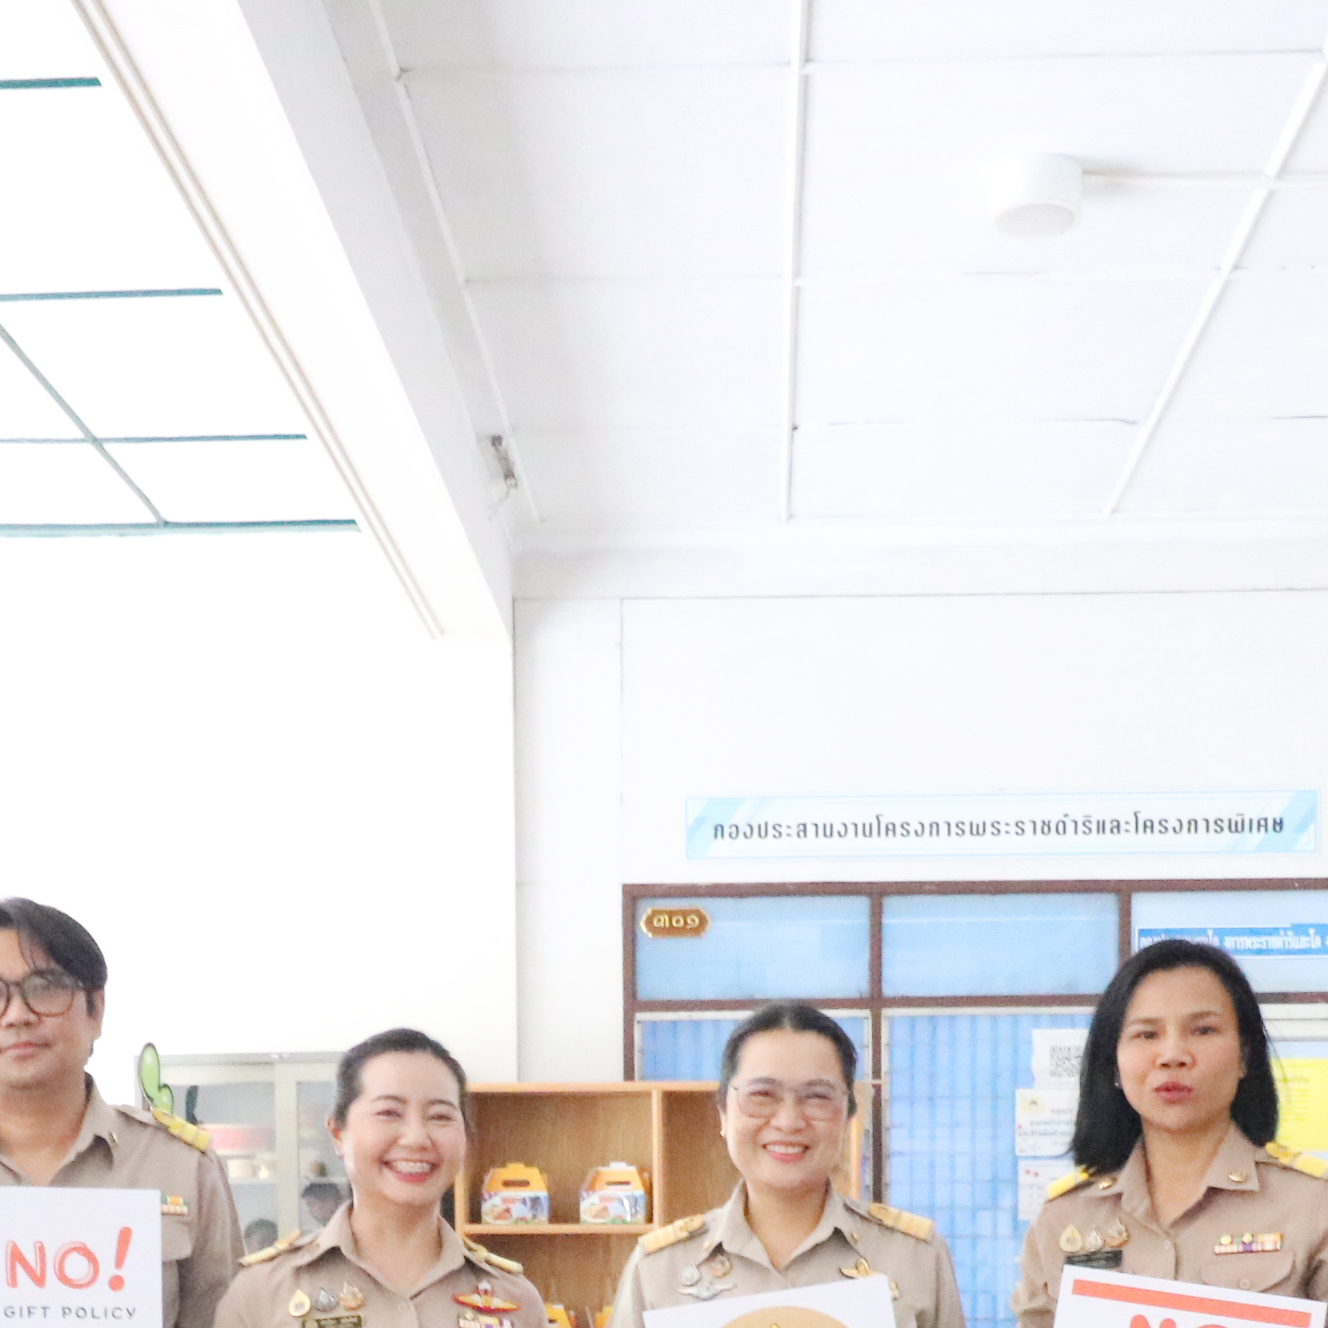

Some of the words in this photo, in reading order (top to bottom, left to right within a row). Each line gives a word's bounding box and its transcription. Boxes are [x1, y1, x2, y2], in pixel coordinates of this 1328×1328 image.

[713, 811, 1285, 840] กองประสานงานโครงการพระราชดำริและโครงการพิเศษ
[653, 914, 700, 929] ๓๐๑
[5, 1227, 132, 1292] NO!
[4, 1306, 51, 1319] GIFT
[62, 1306, 136, 1320] POLICY
